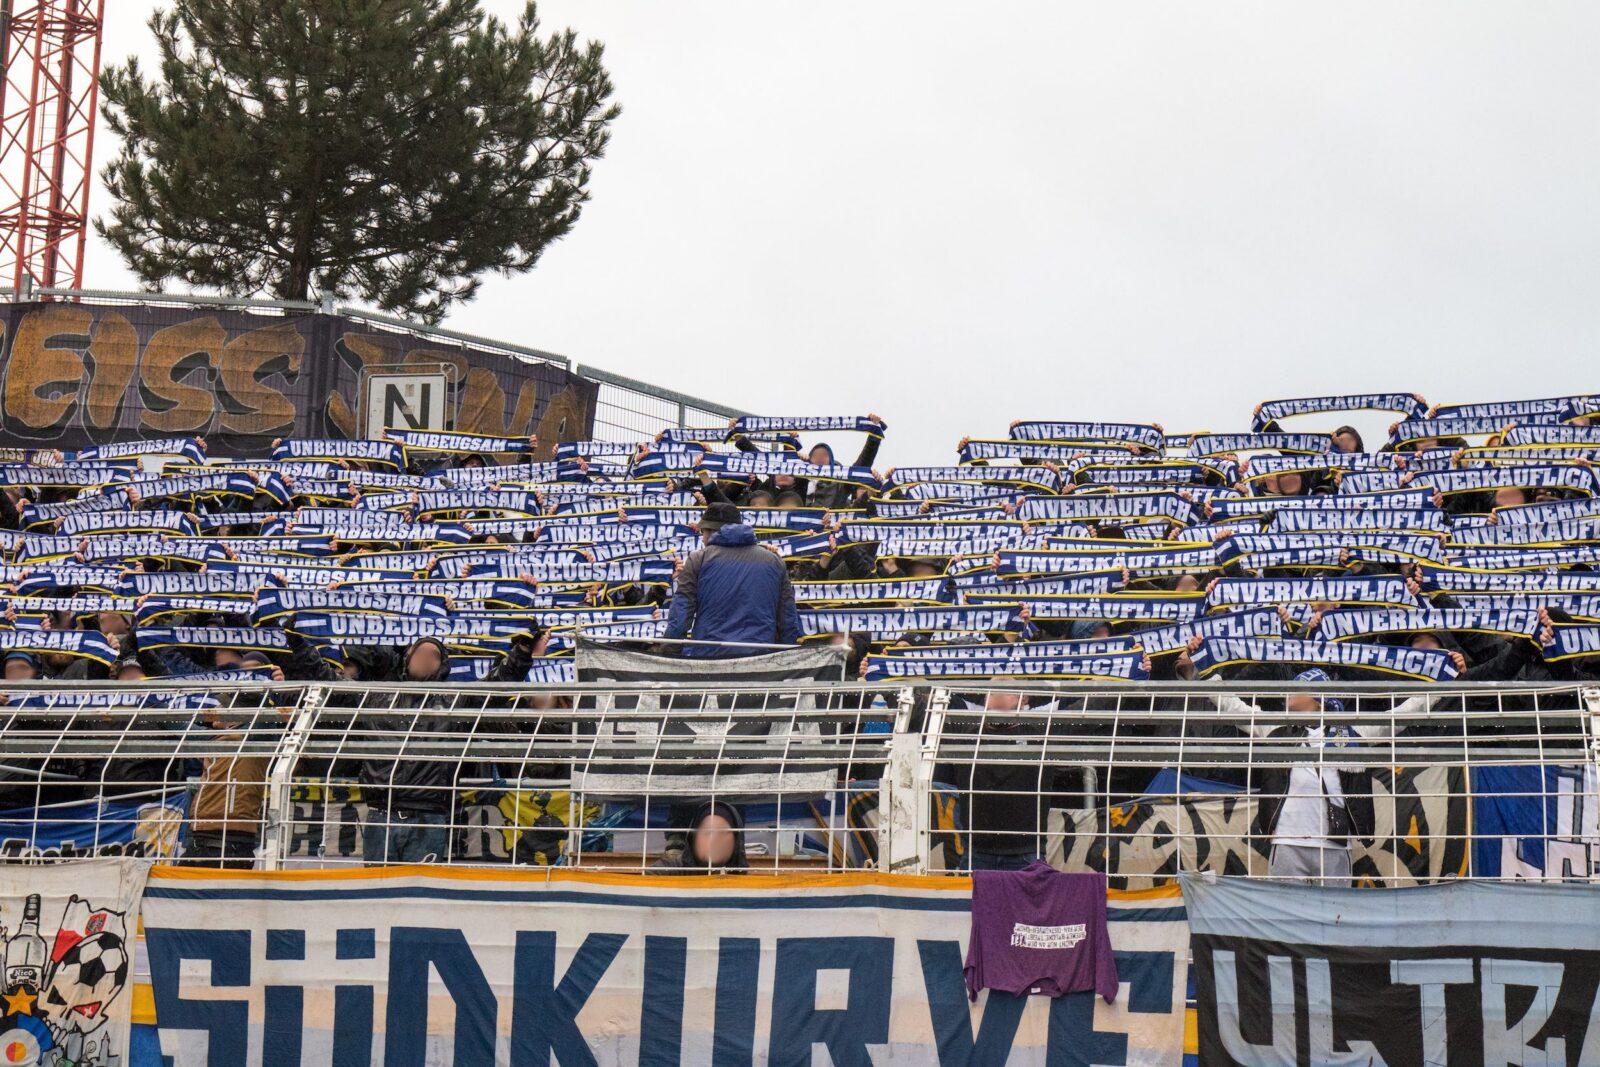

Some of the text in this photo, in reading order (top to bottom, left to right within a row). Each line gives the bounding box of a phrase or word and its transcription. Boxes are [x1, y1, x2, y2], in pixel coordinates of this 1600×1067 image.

[0, 308, 305, 436] EISS
[744, 416, 858, 432] UNBEUGSAM
[99, 440, 187, 459] UNBEUGSAM
[290, 440, 395, 460] UNBEUGSAM
[406, 432, 508, 452] UNBEUGSAM
[577, 442, 687, 457] UNBEUSAM
[6, 469, 114, 486] UNBEUGSAM
[726, 457, 850, 481] UNBEUGSAM
[133, 475, 228, 499] NBEUGSAM
[419, 491, 528, 511] NBEUGSAM
[1019, 494, 1192, 527] UNVERKÄUFLICH
[64, 511, 183, 535] UNBEUGSAM
[322, 523, 439, 540] UNBEUGSAM
[548, 525, 675, 544] UNBEUGSAM
[1016, 549, 1215, 573] UNVERKÄUFLICH
[500, 562, 642, 581] UNBEUGSAM
[137, 573, 267, 593] UNBEUGSAM
[1208, 577, 1419, 607] UNVERKÄUFLICH
[12, 598, 134, 612] NBEUGSAM
[279, 590, 425, 614] UNBEUGSAM
[331, 614, 491, 639] UNBEUGSAM
[800, 608, 1010, 635] UNVERKÄUFLICH
[174, 628, 289, 647] UNBEUGS
[886, 657, 1133, 679] UNVERKÄUFLICH
